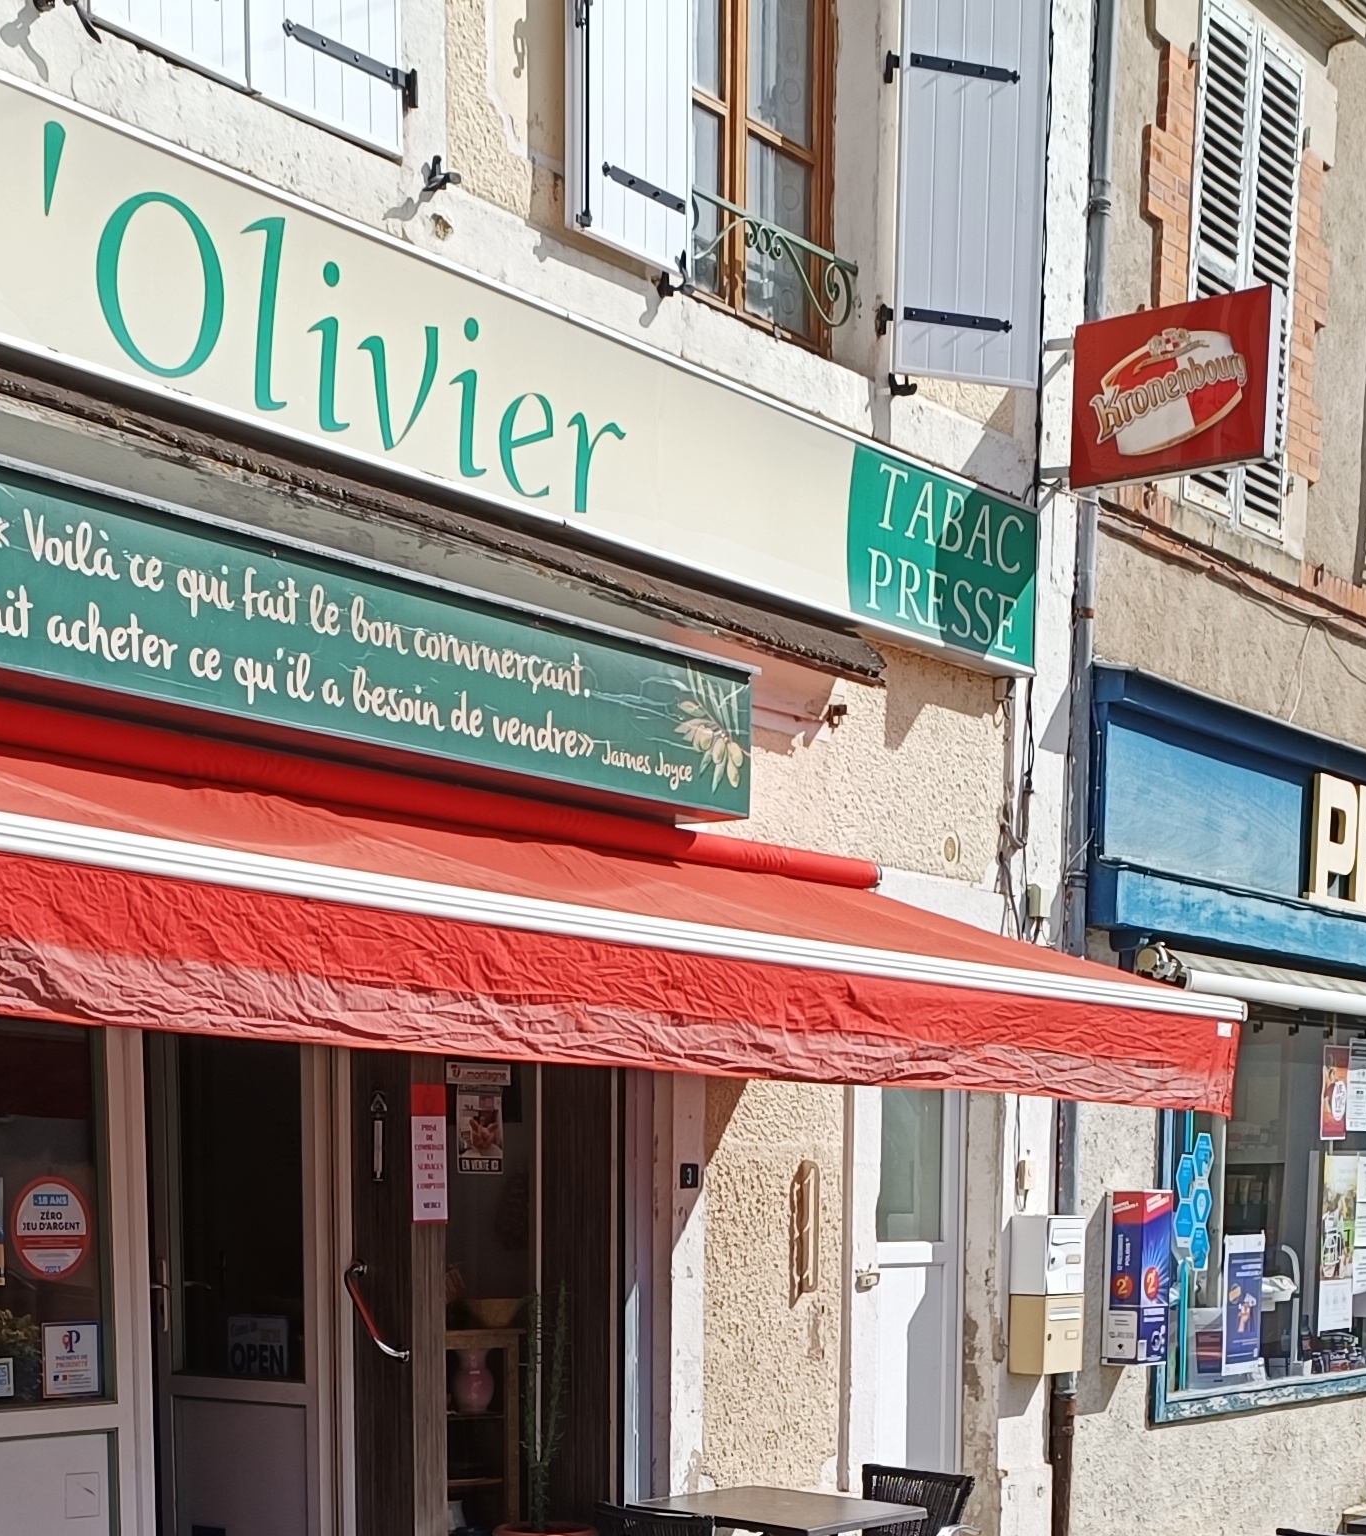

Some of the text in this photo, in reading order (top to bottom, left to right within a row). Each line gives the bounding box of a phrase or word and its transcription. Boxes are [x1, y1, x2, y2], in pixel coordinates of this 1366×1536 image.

[1090, 353, 1247, 444] Kronenbourg
[878, 463, 1024, 574] TABAC
[23, 508, 120, 579] Voilà
[129, 554, 164, 592] ce
[177, 565, 235, 617] qui
[242, 567, 299, 624] fait
[310, 584, 341, 636] le
[351, 596, 408, 656] bon
[866, 547, 1017, 654] PRESSE
[47, 602, 178, 669] acheter
[190, 646, 222, 681] ce
[235, 646, 315, 704] qu'il
[322, 679, 344, 708] a
[352, 666, 445, 732] besoin
[450, 690, 485, 738] de
[600, 739, 652, 776] James
[655, 758, 693, 795] Joyce
[471, 1160, 489, 1170] VENTE
[22, 1222, 80, 1231] JEU D'ARGENT
[40, 1210, 62, 1220] ZÉRO
[50, 1196, 67, 1205] ANS
[231, 1343, 284, 1376] OPEN
